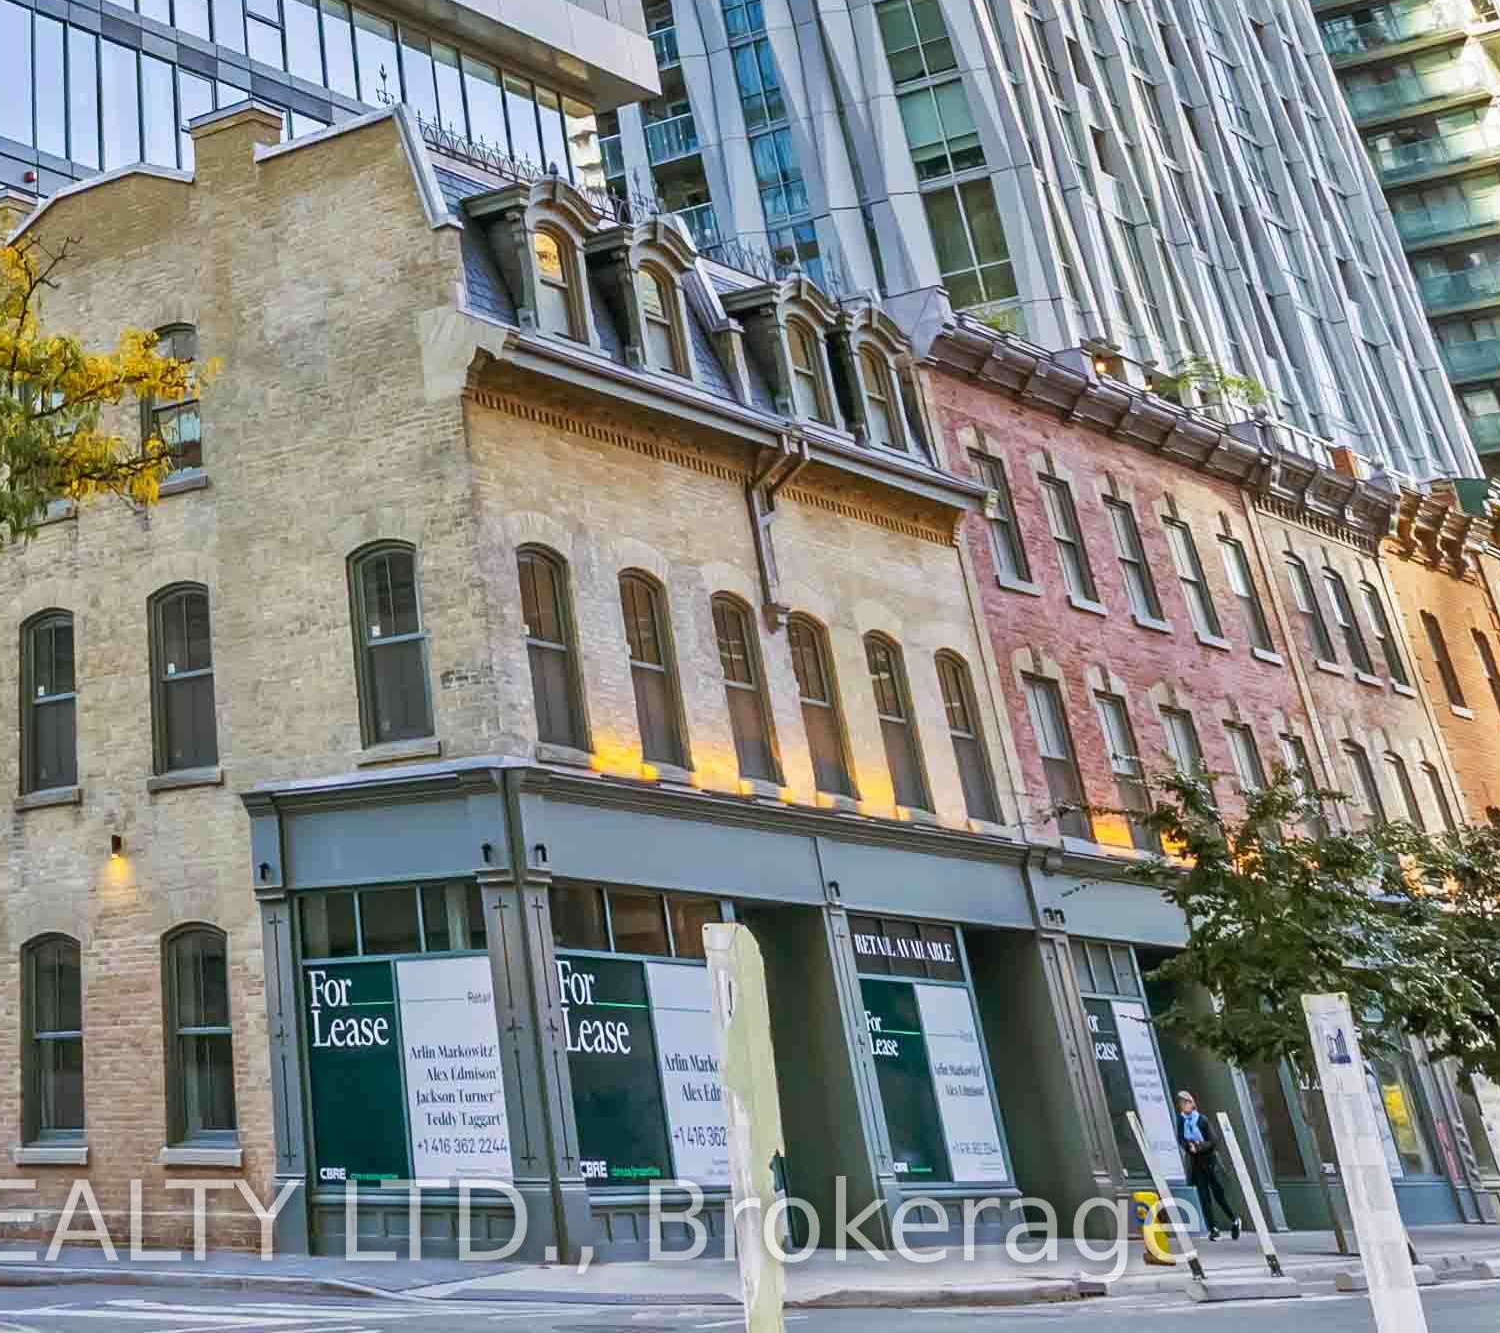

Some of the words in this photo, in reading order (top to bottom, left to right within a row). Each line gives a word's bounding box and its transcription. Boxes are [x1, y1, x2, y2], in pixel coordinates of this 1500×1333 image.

[854, 934, 896, 957] RETAIL
[896, 938, 954, 962] AVAILABLE
[307, 970, 352, 1008] For
[554, 960, 596, 1006] For
[311, 1009, 390, 1048] Lease
[561, 1007, 631, 1054] Lease
[863, 1010, 882, 1033] For
[1086, 1014, 1100, 1032] or
[869, 1037, 900, 1057] Lease
[1095, 1041, 1119, 1061] ease
[431, 1138, 452, 1153] 416
[454, 1138, 475, 1153] 362
[478, 1138, 507, 1153] 2244
[706, 1126, 727, 1147] 362
[320, 1167, 346, 1180] CBRE
[580, 1160, 607, 1177] CBRE
